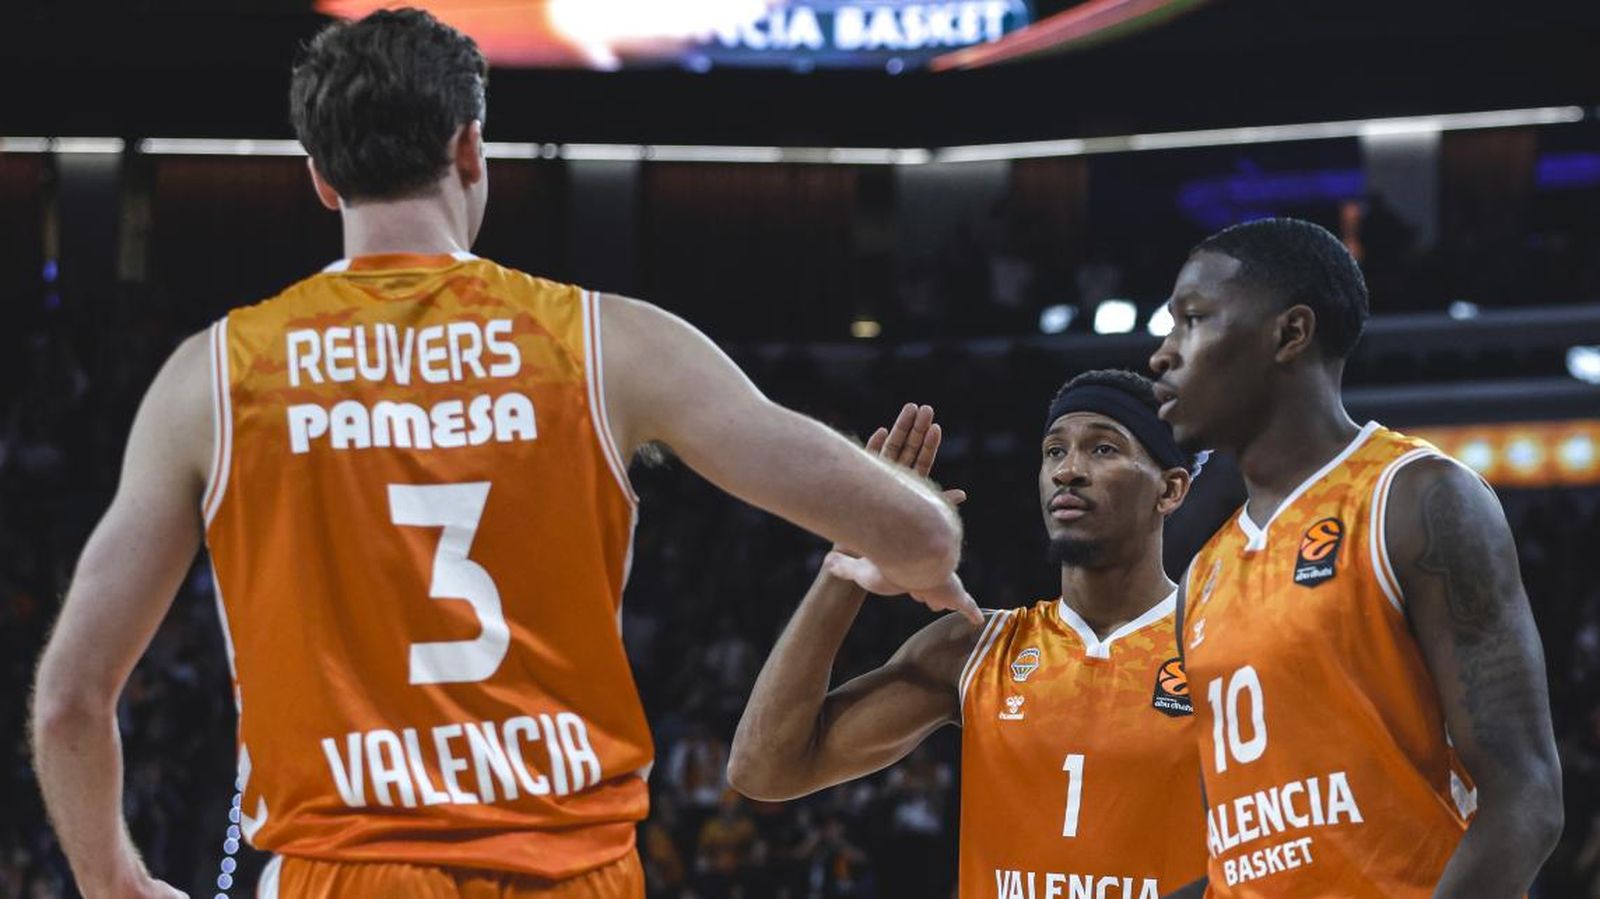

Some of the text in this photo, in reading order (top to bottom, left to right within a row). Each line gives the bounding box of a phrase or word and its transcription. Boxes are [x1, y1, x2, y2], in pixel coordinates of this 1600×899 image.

[832, 1, 1008, 50] BASKET
[286, 318, 521, 387] REUVERS
[286, 391, 538, 454] PAMESA
[387, 481, 511, 685] 3
[321, 711, 602, 808] VALENCIA
[1207, 665, 1268, 773] 10
[1062, 753, 1085, 838] 1
[1207, 771, 1364, 859] ALENCIA
[1223, 836, 1313, 887] BASKET
